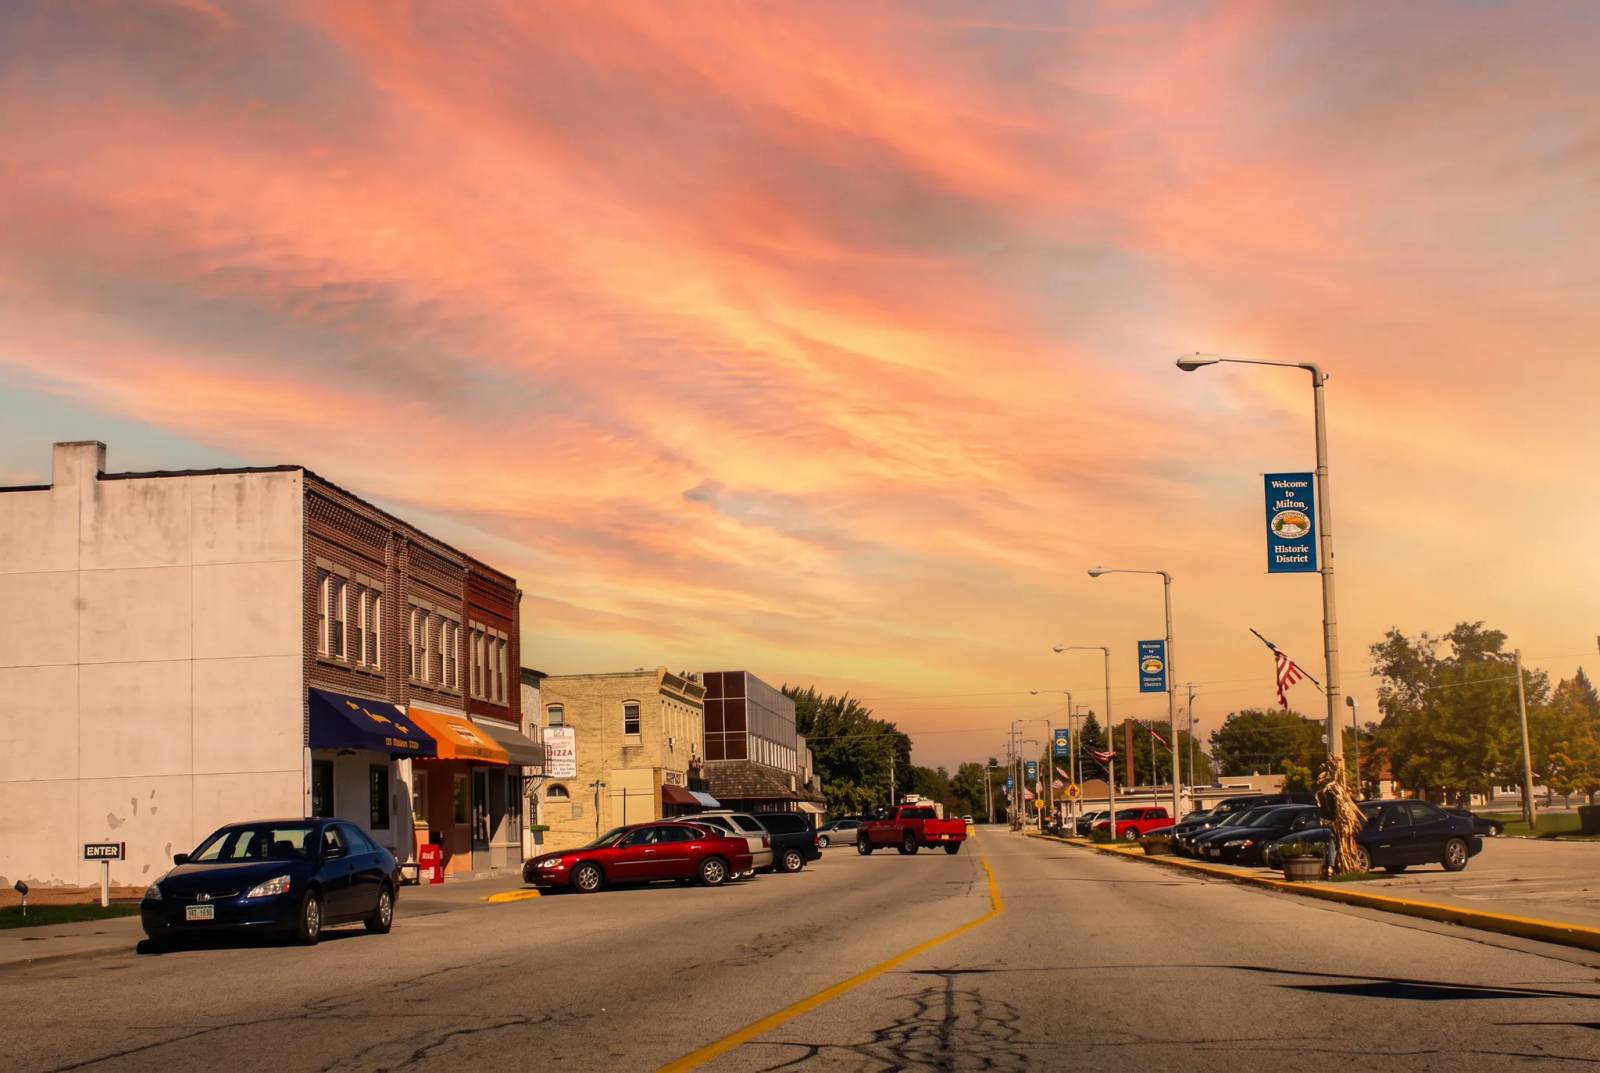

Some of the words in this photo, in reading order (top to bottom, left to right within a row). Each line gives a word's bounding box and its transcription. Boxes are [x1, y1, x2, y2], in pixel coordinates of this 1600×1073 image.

[1272, 480, 1308, 488] Welcome
[1275, 499, 1305, 509] Milton
[1274, 545, 1309, 553] Historic
[1276, 555, 1309, 563] District
[87, 846, 119, 856] ENTER
